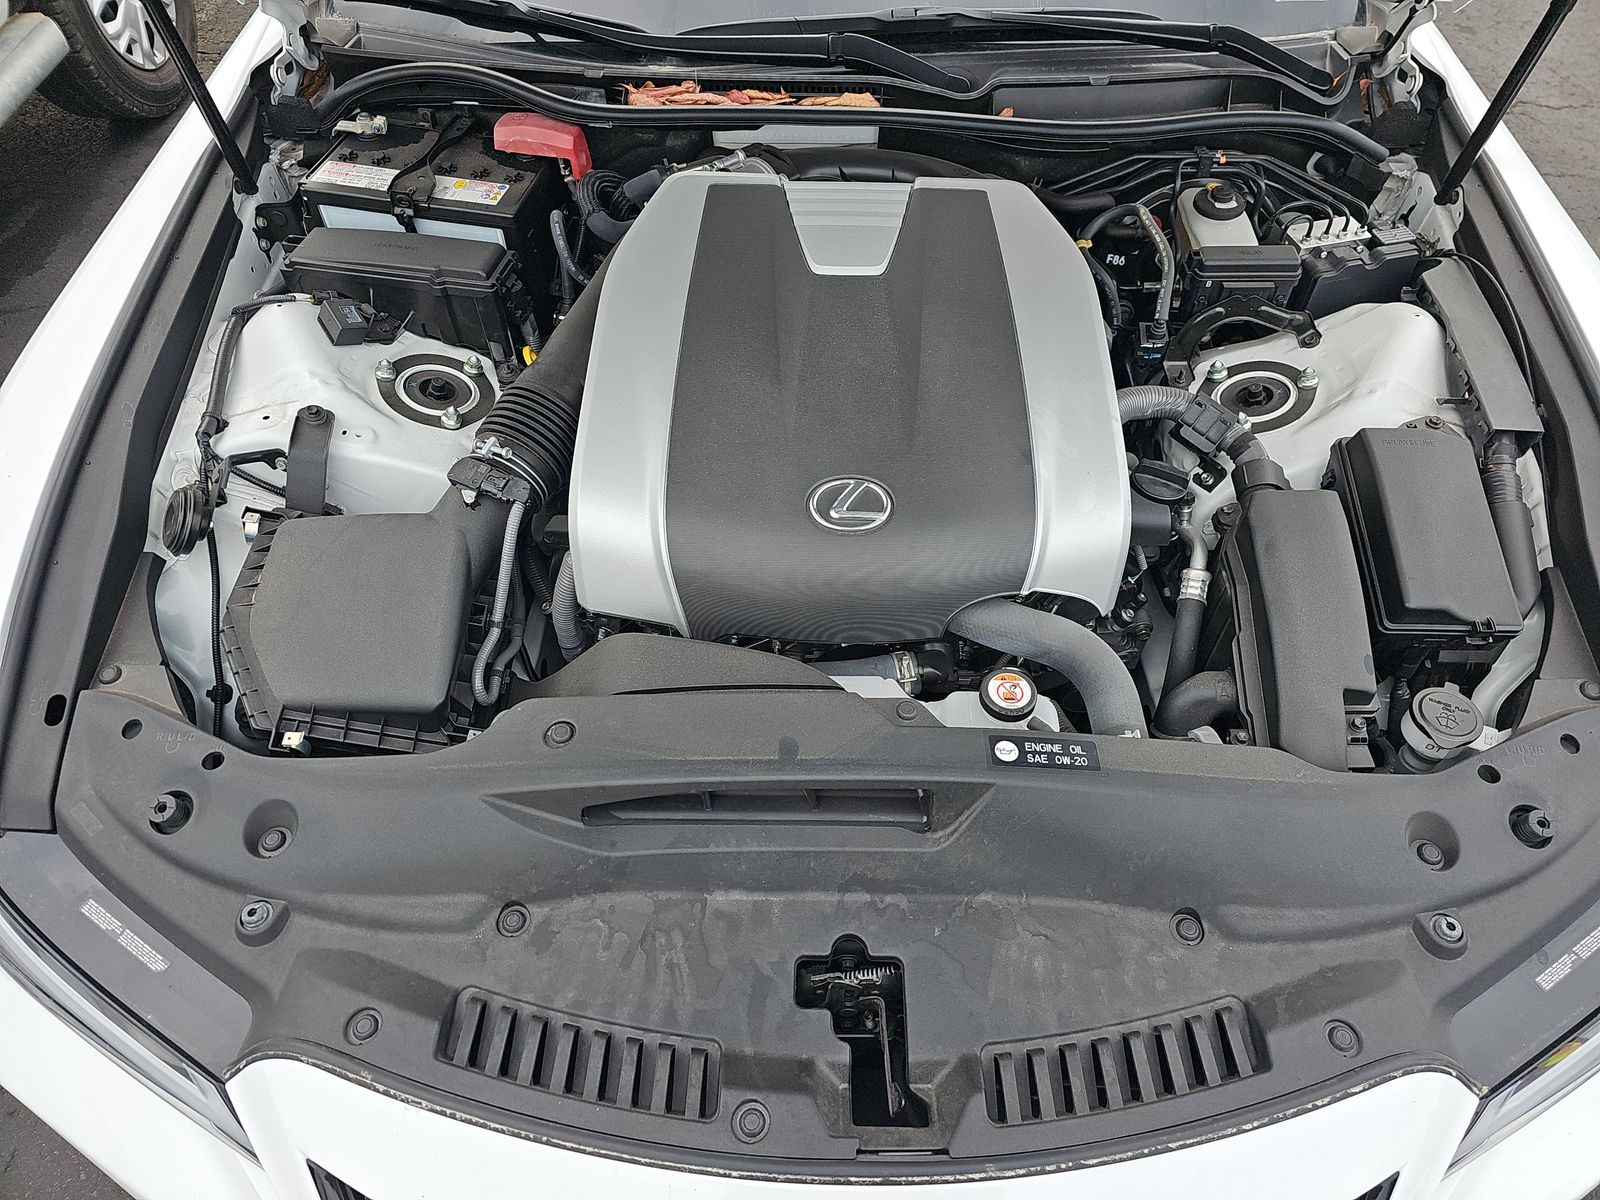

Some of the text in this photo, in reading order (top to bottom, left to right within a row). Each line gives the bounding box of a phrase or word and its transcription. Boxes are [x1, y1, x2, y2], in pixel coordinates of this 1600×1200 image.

[1105, 253, 1126, 266] F86
[1024, 742, 1087, 755] ENGINE OIL
[1026, 753, 1088, 766] SAE 0W-20
